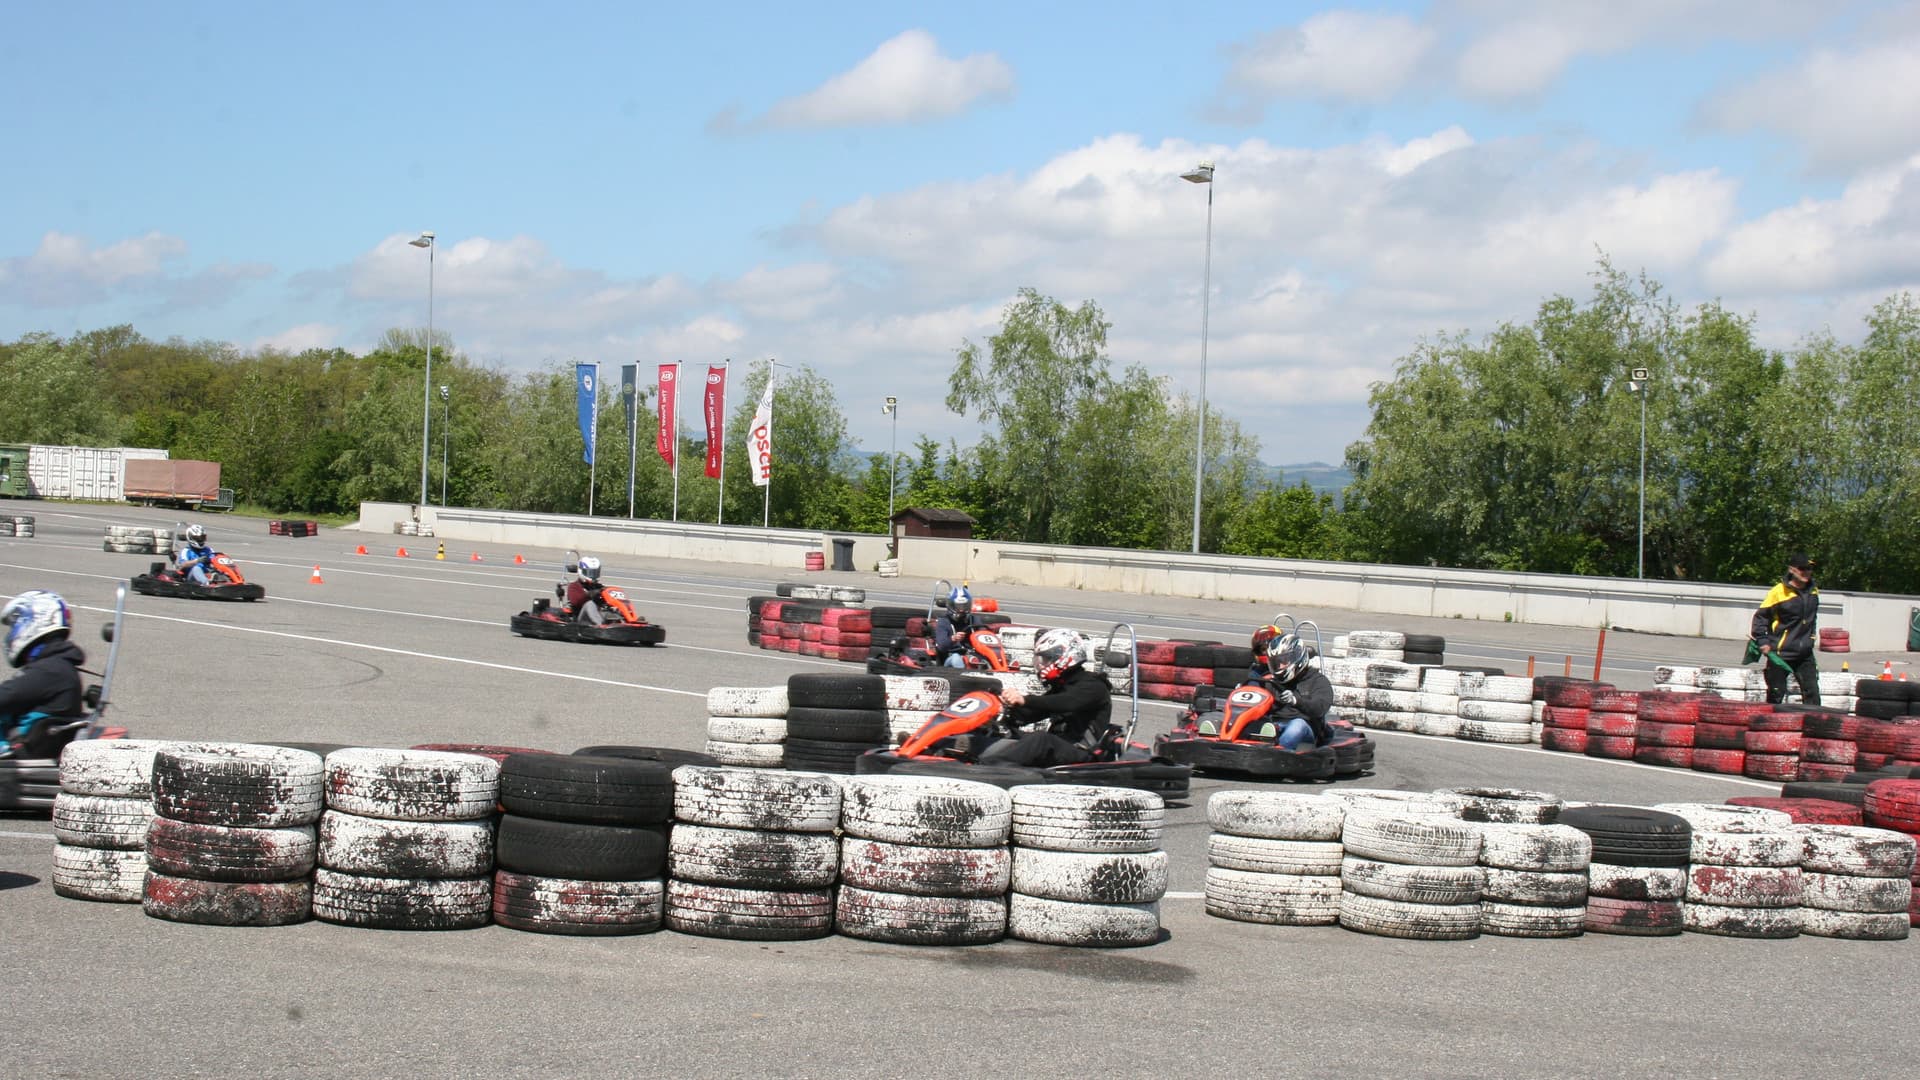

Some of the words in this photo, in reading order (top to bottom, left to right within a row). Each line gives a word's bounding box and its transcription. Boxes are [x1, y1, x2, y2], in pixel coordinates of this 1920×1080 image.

[754, 425, 772, 479] OSCH
[1240, 692, 1254, 701] 9
[957, 700, 974, 710] 4
